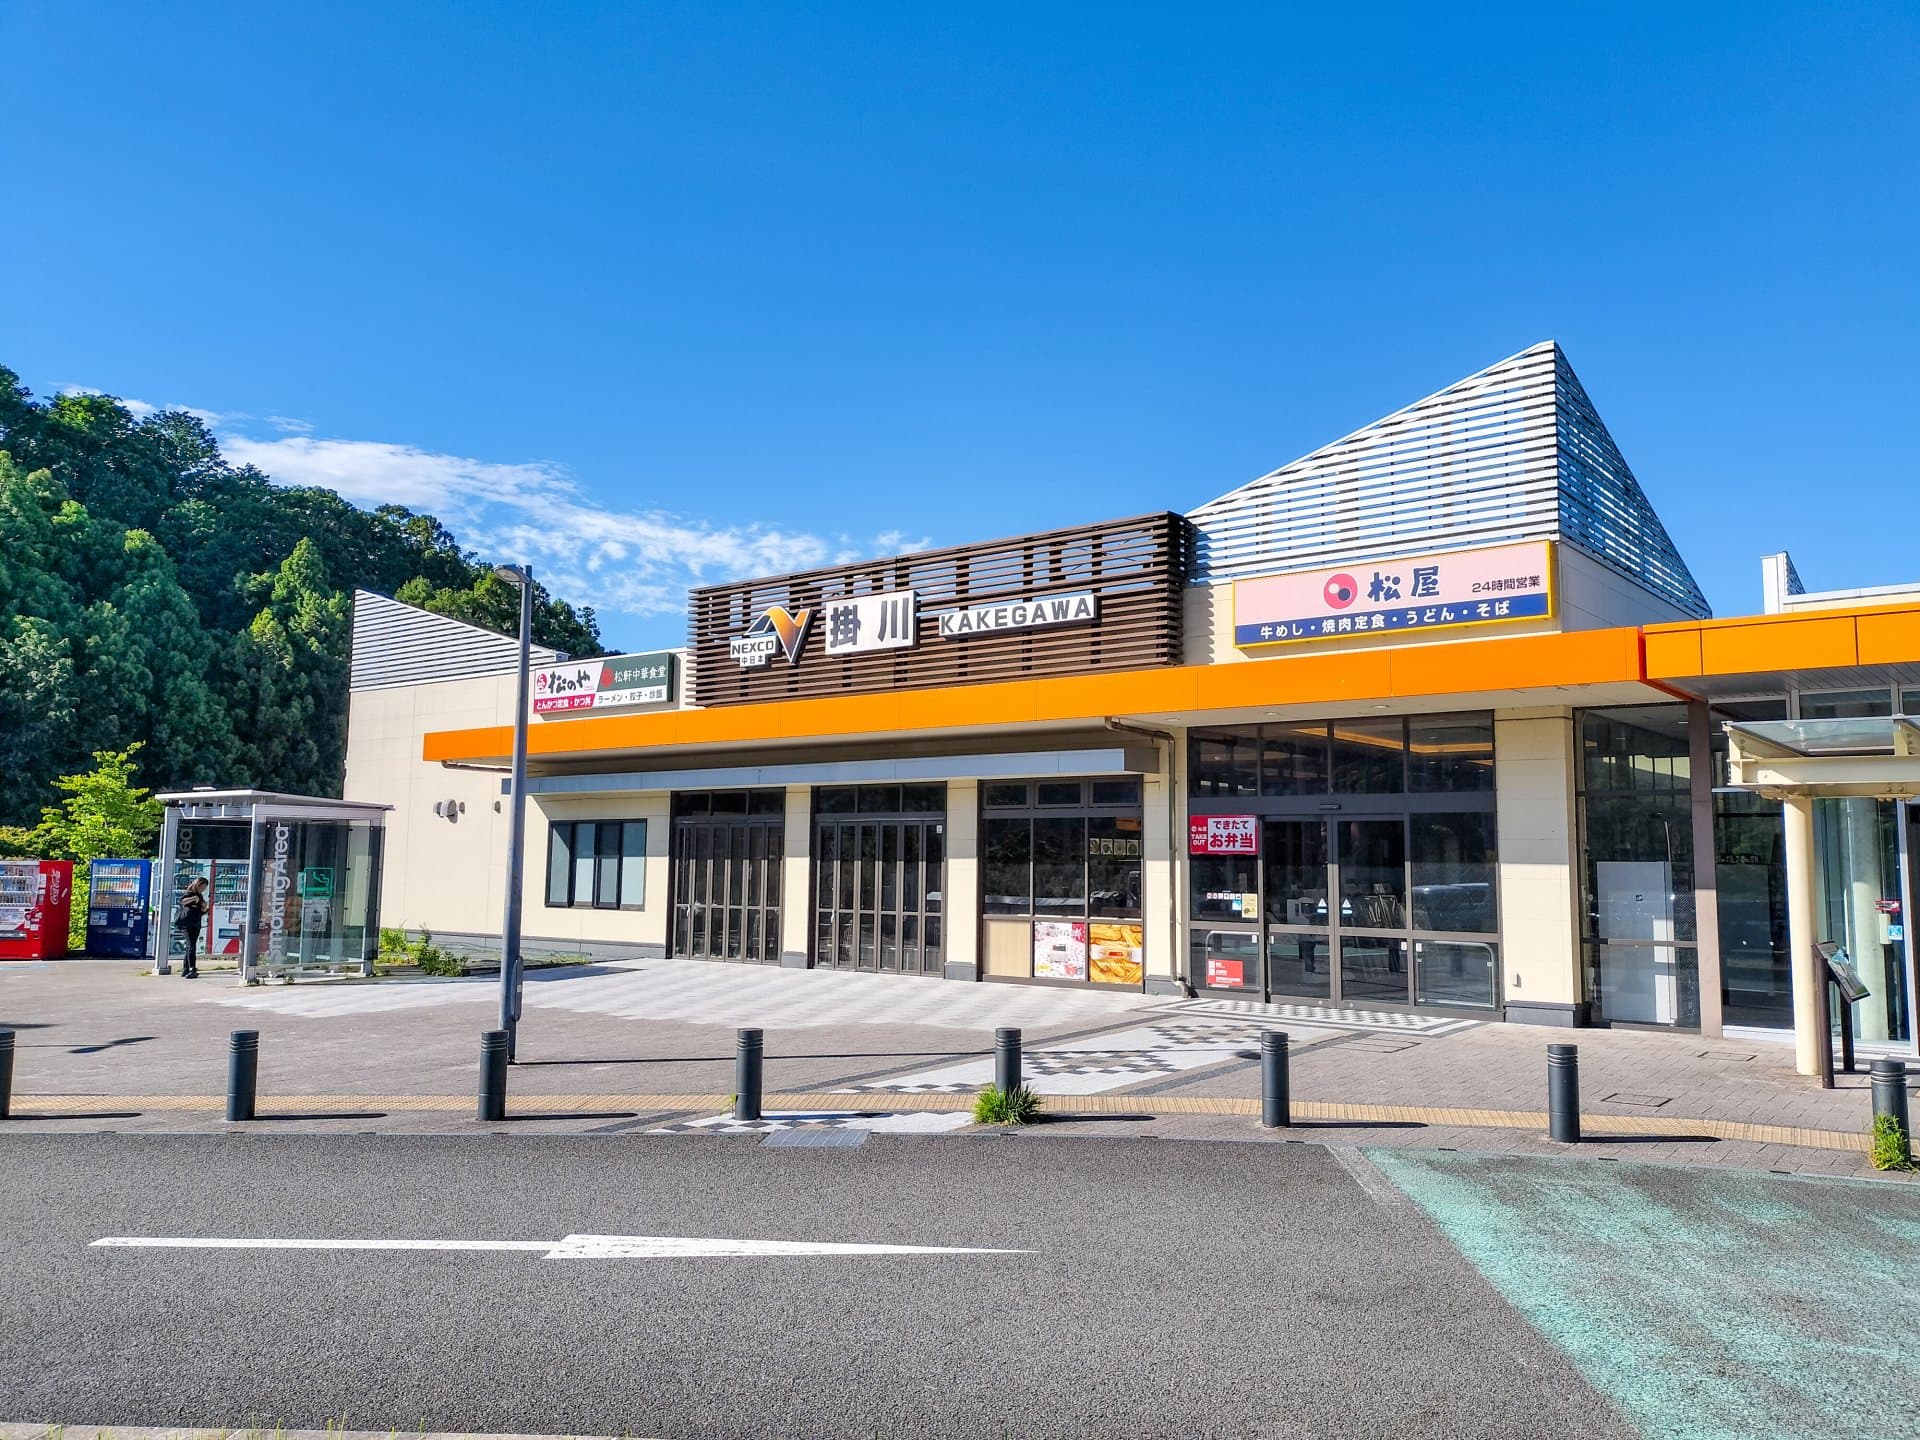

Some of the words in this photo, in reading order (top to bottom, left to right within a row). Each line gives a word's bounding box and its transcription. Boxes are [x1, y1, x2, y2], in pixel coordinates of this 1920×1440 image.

[1368, 565, 1440, 602] 松屋
[1471, 575, 1540, 593] 24時間営業
[830, 597, 910, 649] 掛川
[941, 597, 1091, 634] KAKEGAWA
[1260, 600, 1510, 640] 牛めし・焼肉定食・うどん・そば
[731, 640, 775, 656] NEXCO
[741, 655, 764, 665] 中日本
[548, 668, 591, 694] 松のや
[613, 665, 666, 683] 松軒中華食堂
[1213, 820, 1249, 830] できたて
[270, 825, 289, 873] Area
[1209, 832, 1253, 848] お弁当
[265, 877, 291, 961] Smoking
